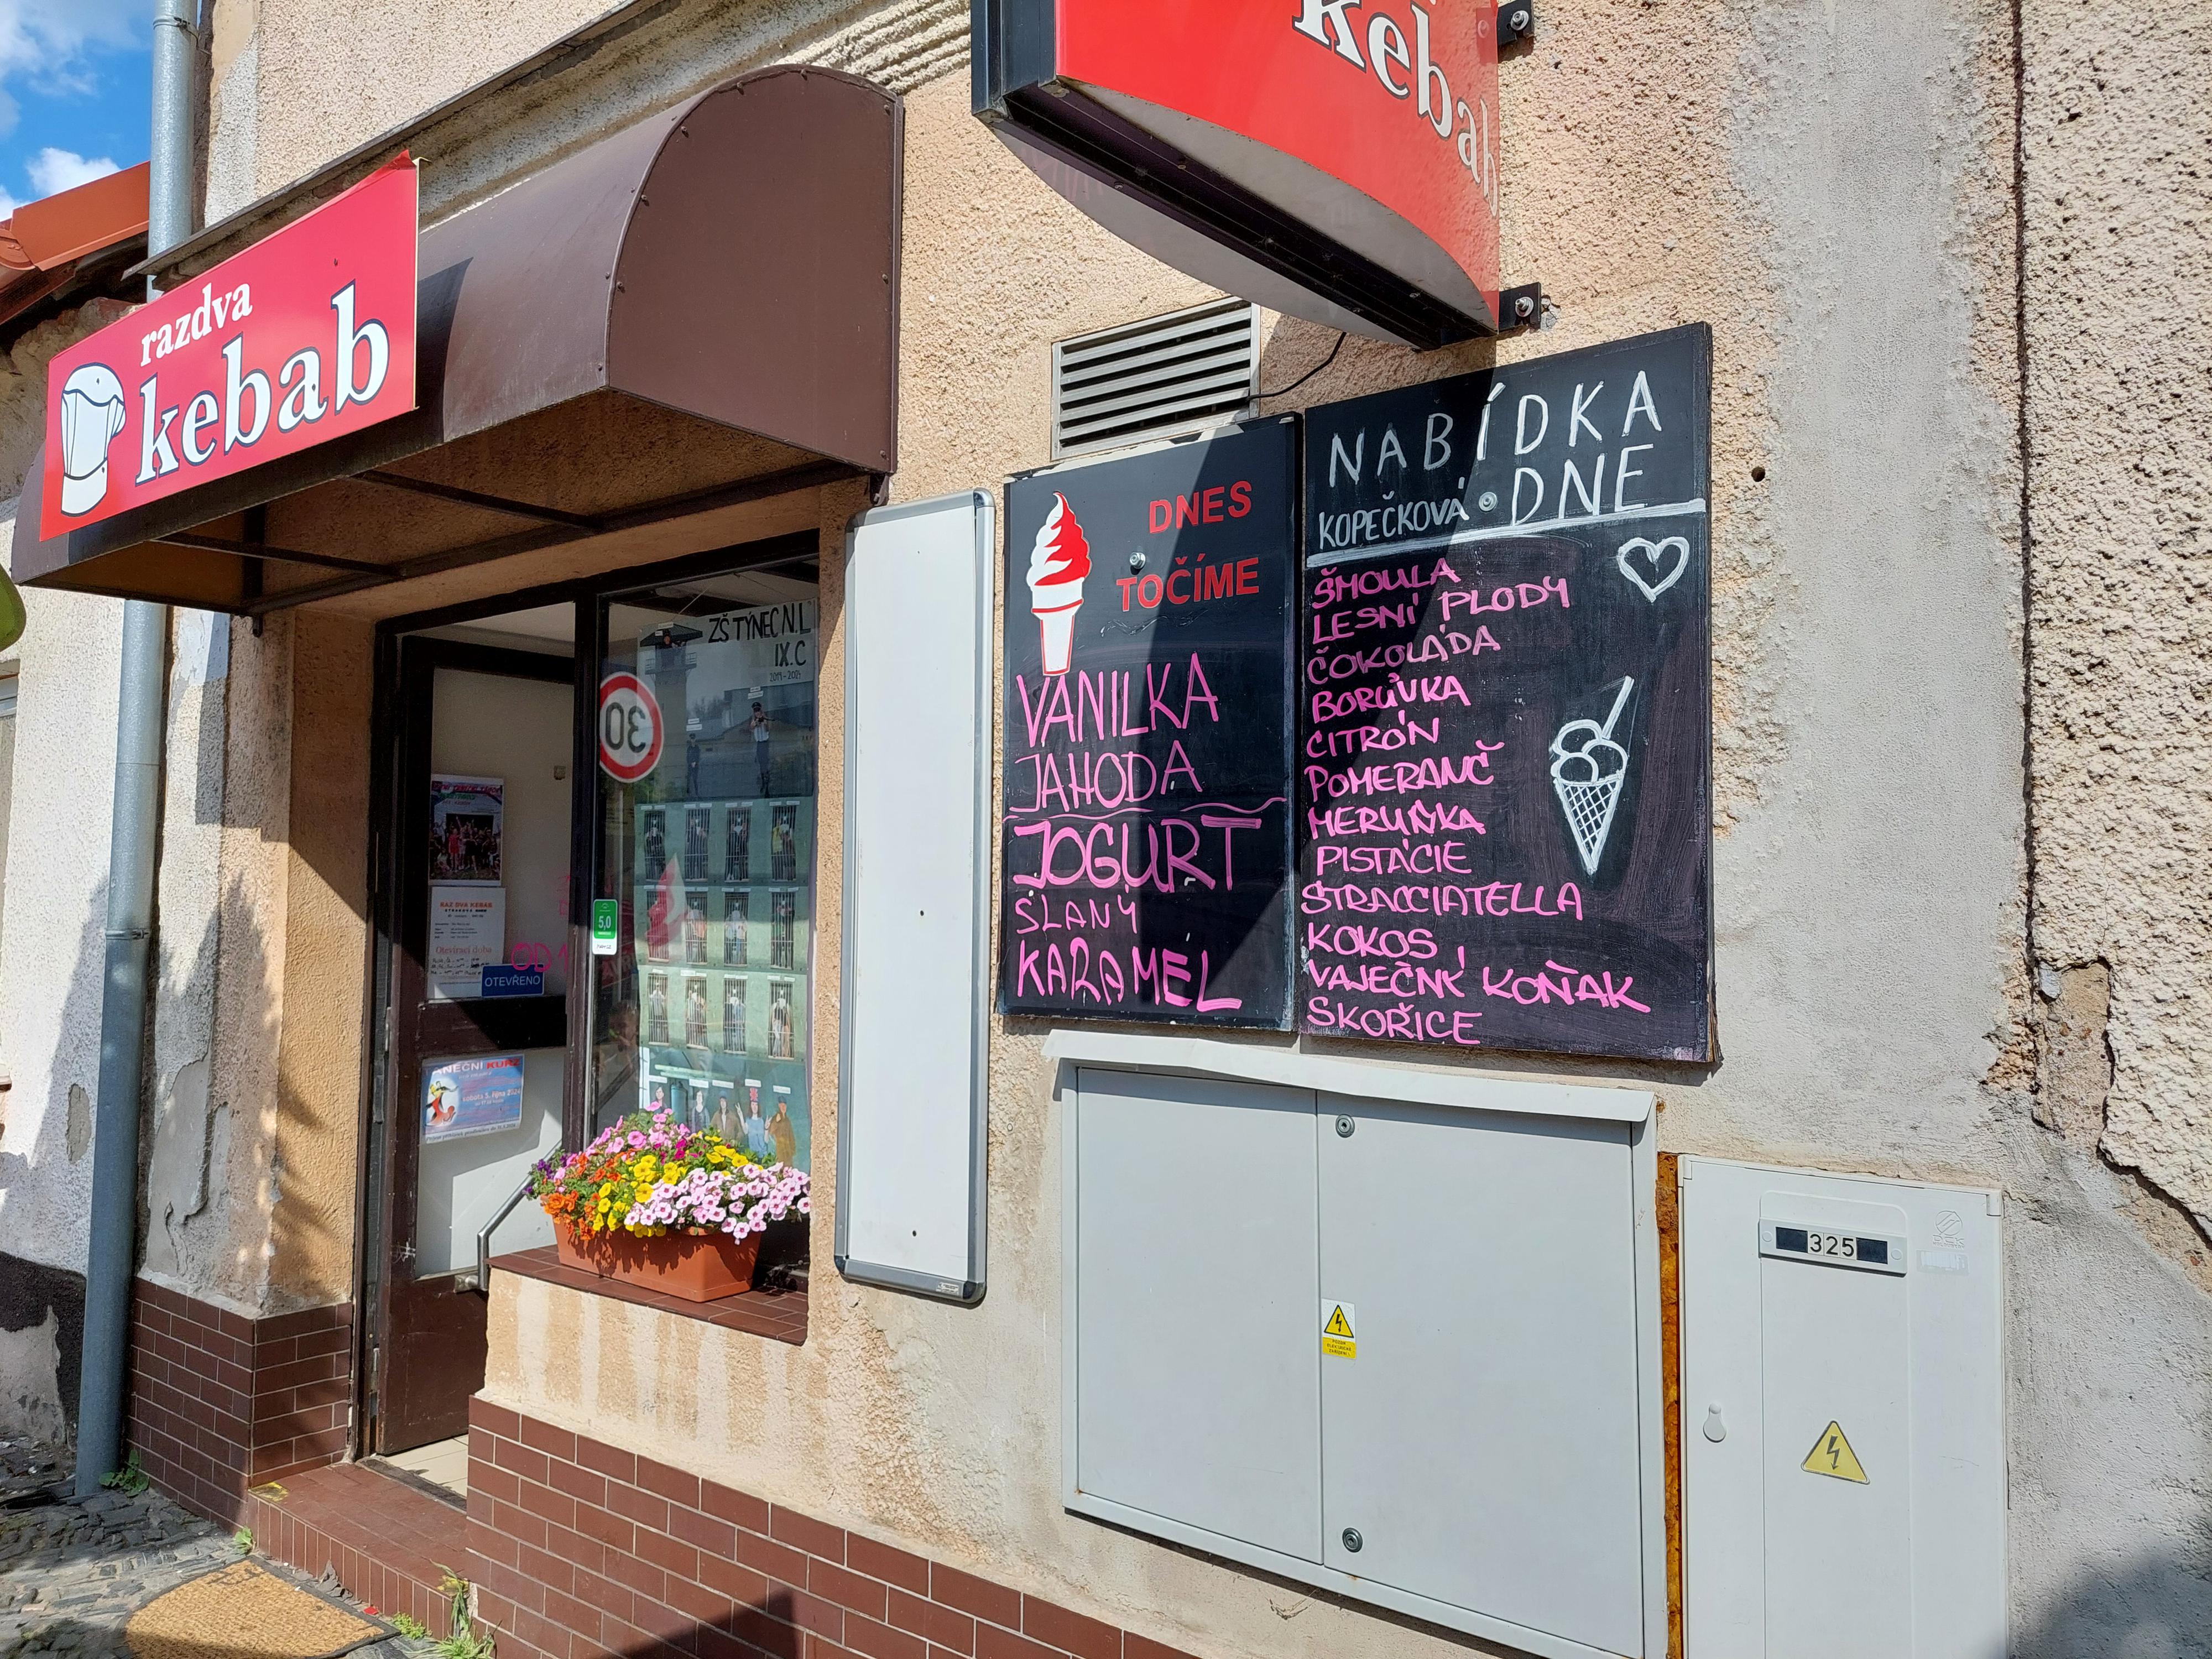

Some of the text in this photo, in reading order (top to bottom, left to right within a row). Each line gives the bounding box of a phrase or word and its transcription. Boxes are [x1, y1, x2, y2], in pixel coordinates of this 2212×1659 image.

[140, 283, 253, 367] razdva
[134, 279, 390, 487] kebab
[1329, 370, 1662, 488] NABÍDKA
[1149, 481, 1253, 534] DNES
[1319, 477, 1469, 549] KOPEČKOVÁ
[1511, 444, 1654, 526] DNE
[1116, 554, 1259, 612] TOČÍME
[1312, 557, 1461, 609] ŠMOULA
[1313, 576, 1570, 644] LESNÍ PLODY
[1307, 624, 1501, 685] ČOKOLÁDA
[1016, 651, 1219, 748] VANILKA
[1313, 672, 1471, 723] BORŮVKA
[1010, 740, 1203, 812] JAHODA
[1304, 740, 1505, 802] POMERANČ
[1013, 814, 1262, 893] JOGURT
[1317, 838, 1472, 876] PISTÁCIE
[598, 915, 611, 930] 5,0
[1301, 881, 1583, 920] STRACCIATELLA
[511, 942, 551, 973] OD
[1308, 922, 1438, 959] KOKOS
[484, 974, 541, 987] OTEVŘENO
[1017, 937, 1242, 1013] KARAMEL
[1307, 997, 1483, 1044] SKOŘICE
[1810, 1233, 1855, 1257] 325
